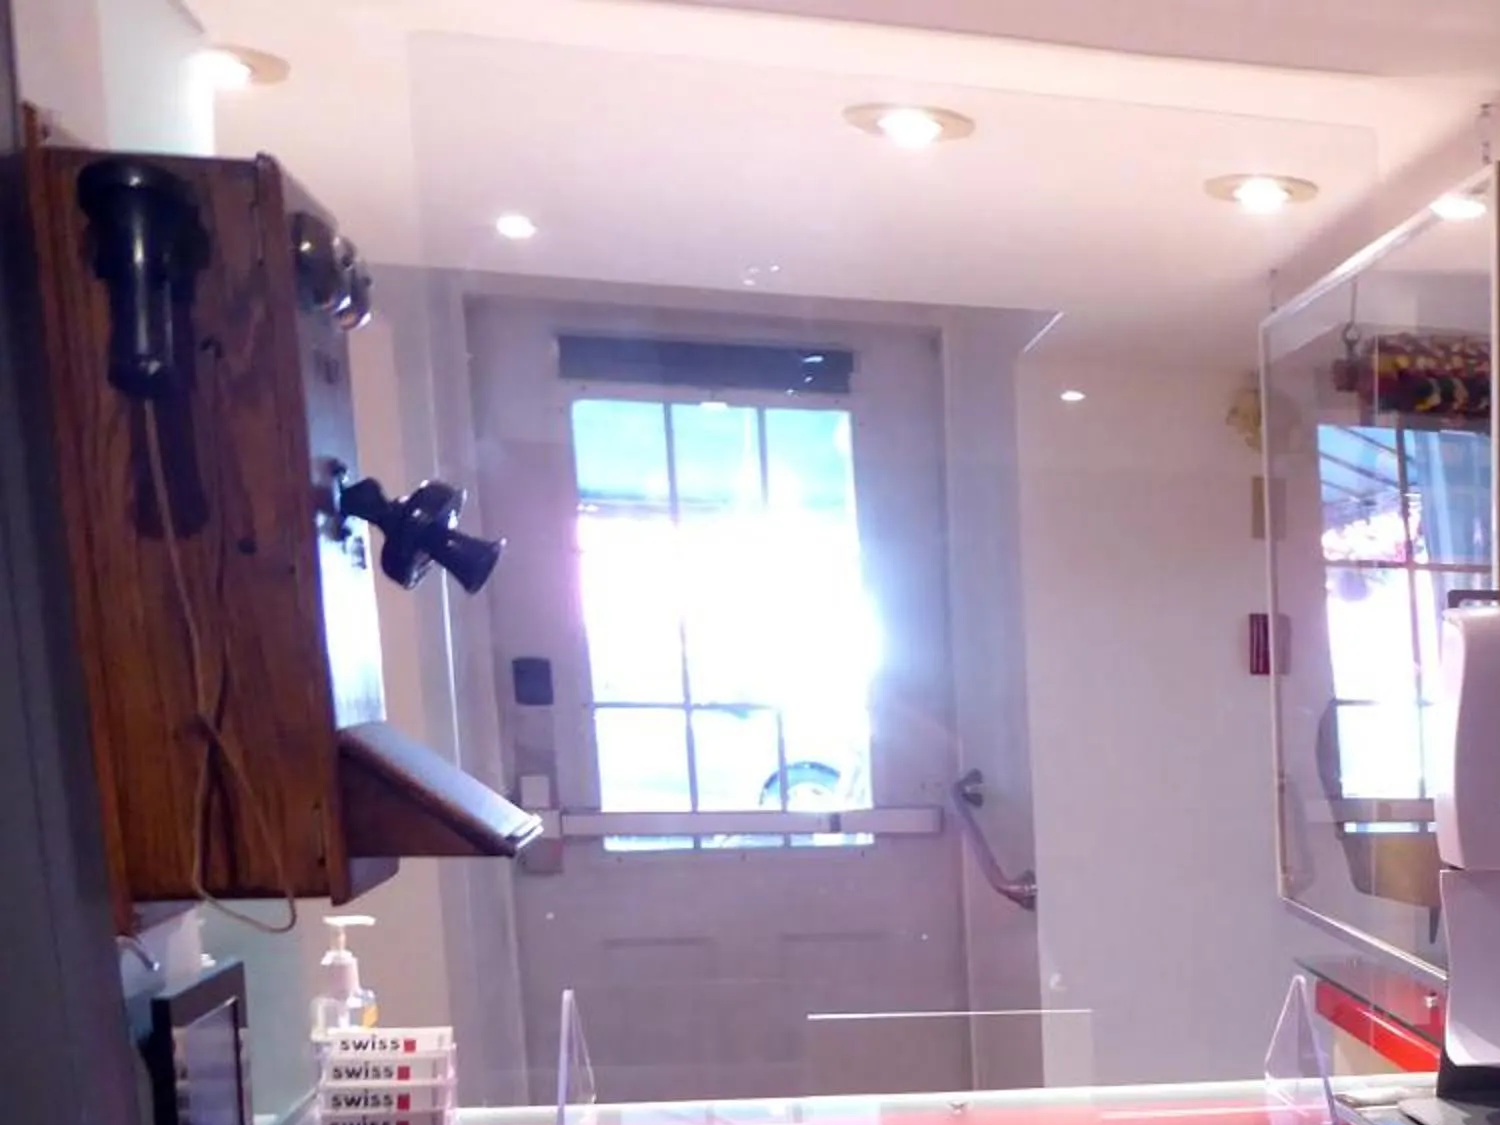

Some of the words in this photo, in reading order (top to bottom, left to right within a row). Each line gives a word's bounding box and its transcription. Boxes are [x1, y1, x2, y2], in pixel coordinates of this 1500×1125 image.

[339, 1033, 401, 1052] swiss
[332, 1061, 394, 1080] swiss
[331, 1089, 394, 1110] swiss
